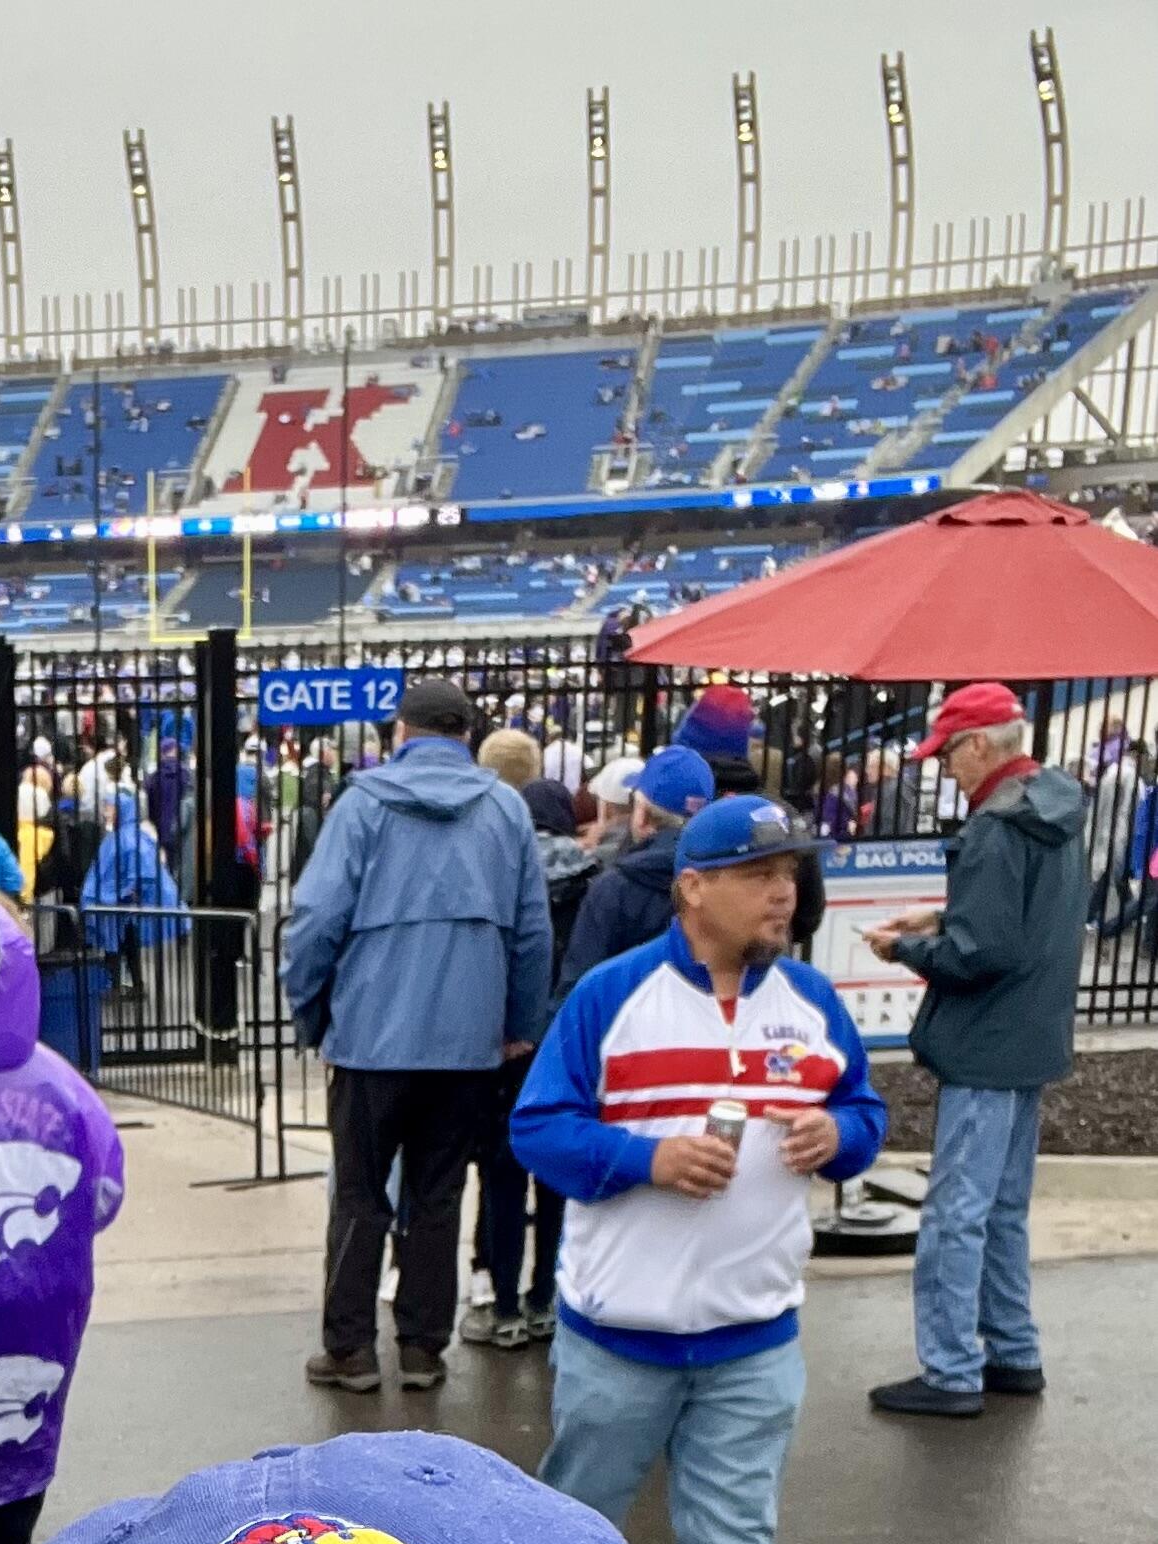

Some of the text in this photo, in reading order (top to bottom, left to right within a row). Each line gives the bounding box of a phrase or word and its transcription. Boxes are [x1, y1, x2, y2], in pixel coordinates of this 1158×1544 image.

[263, 679, 399, 712] GATE 12
[855, 851, 896, 868] BAG
